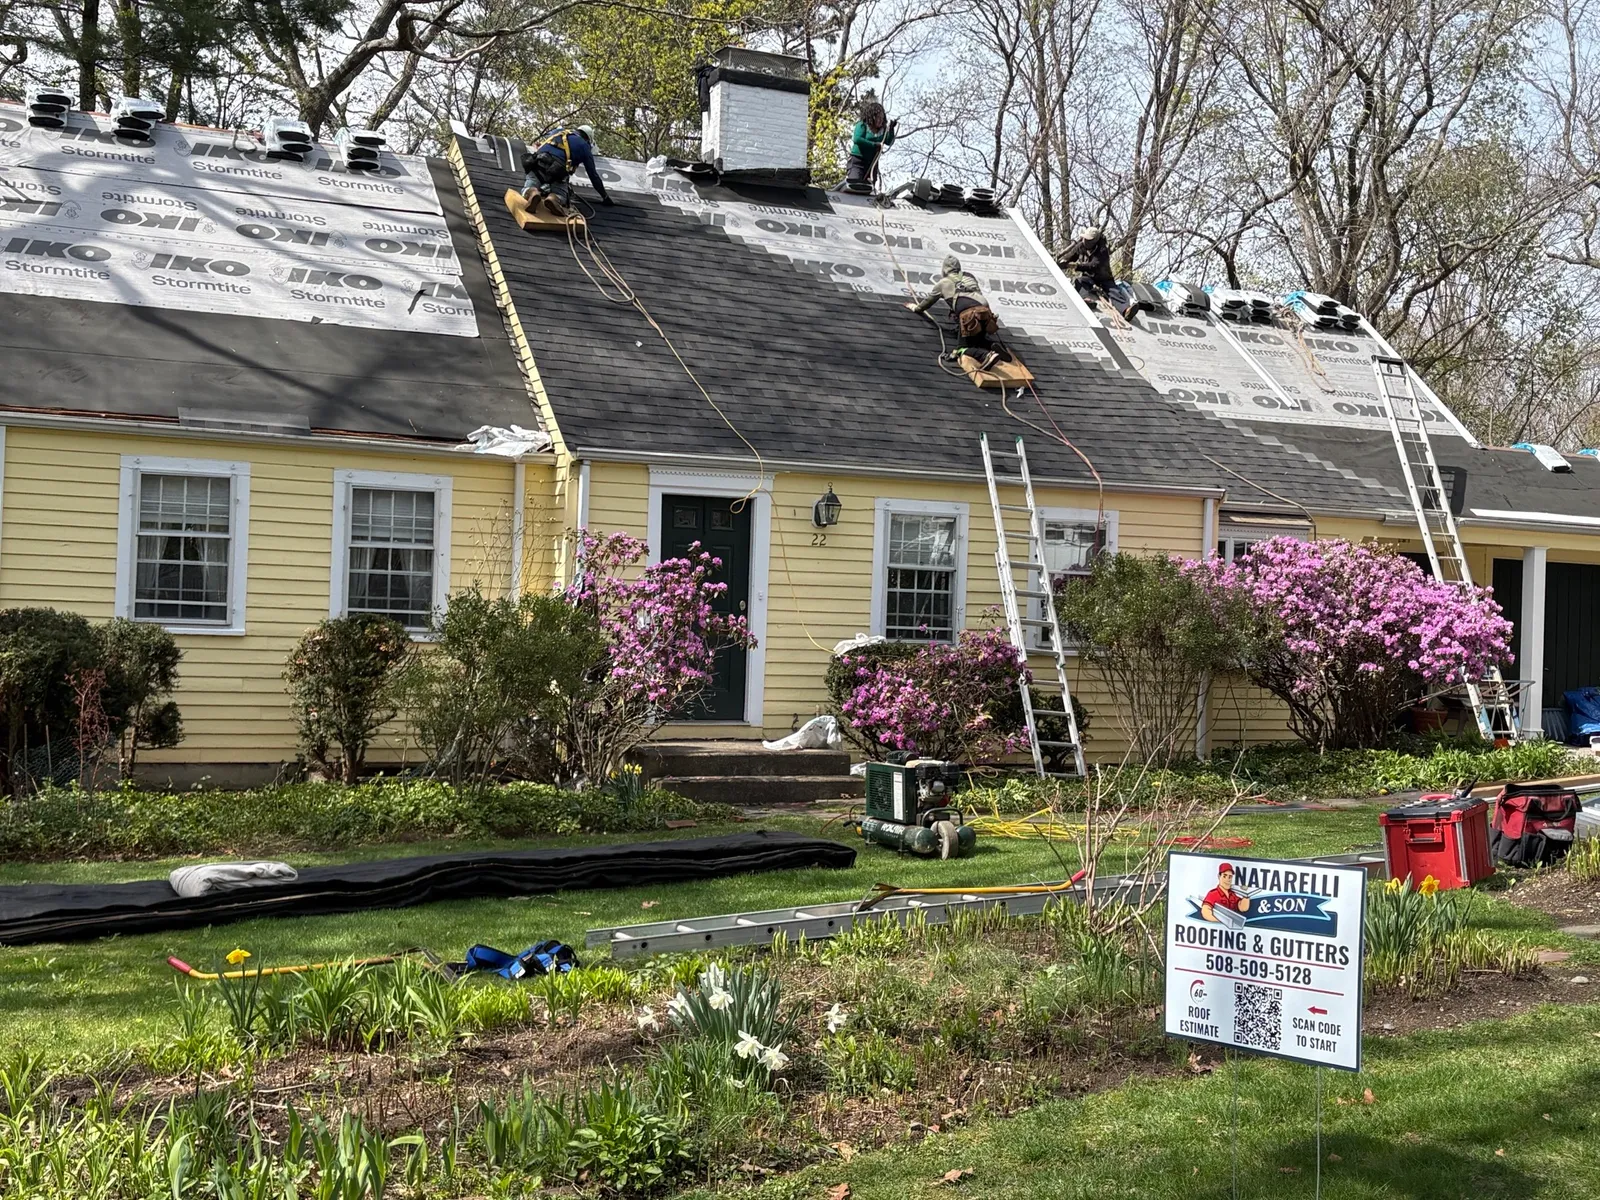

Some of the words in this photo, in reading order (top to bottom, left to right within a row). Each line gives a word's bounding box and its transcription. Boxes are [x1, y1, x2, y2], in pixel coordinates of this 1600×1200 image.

[61, 145, 156, 164] Stormtite
[192, 161, 283, 180] Stormtite
[317, 176, 404, 195] Stormtite
[101, 191, 198, 211] Stormtite
[100, 209, 200, 232] IKO
[235, 207, 327, 226] Stormtite
[748, 204, 820, 221] Stormtite
[235, 224, 330, 246] IKO
[362, 221, 449, 239] Stormtite
[755, 218, 827, 239] IKO
[940, 226, 1007, 242] Stormtite
[4, 237, 112, 262] IKO
[365, 238, 454, 259] IKO
[854, 231, 923, 250] IKO
[948, 241, 1016, 258] IKO
[5, 260, 110, 280] Stormtite
[150, 253, 250, 277] IKO
[152, 274, 252, 294] Stormtite
[287, 268, 383, 291] IKO
[989, 279, 1057, 296] IKO
[290, 289, 386, 309] Stormtite
[998, 296, 1068, 310] Stormtite
[1147, 321, 1207, 338] IKO
[1157, 337, 1218, 352] Stormtite
[1168, 388, 1231, 405] IKO
[811, 533, 827, 547] 22
[1234, 865, 1339, 898] NATARELLI
[1257, 899, 1271, 914] &
[1273, 898, 1308, 913] SON
[1174, 923, 1247, 951] ROOFING
[1253, 934, 1264, 954] &
[1270, 936, 1350, 966] GUTTERS
[1205, 953, 1312, 985] 508-509-5128
[1188, 1005, 1211, 1020] ROOF
[1179, 1019, 1220, 1038] ESTIMATE
[1292, 1017, 1316, 1032] SCAN
[1318, 1021, 1342, 1037] CODE
[1296, 1034, 1307, 1048] TO
[1309, 1037, 1337, 1053] START
